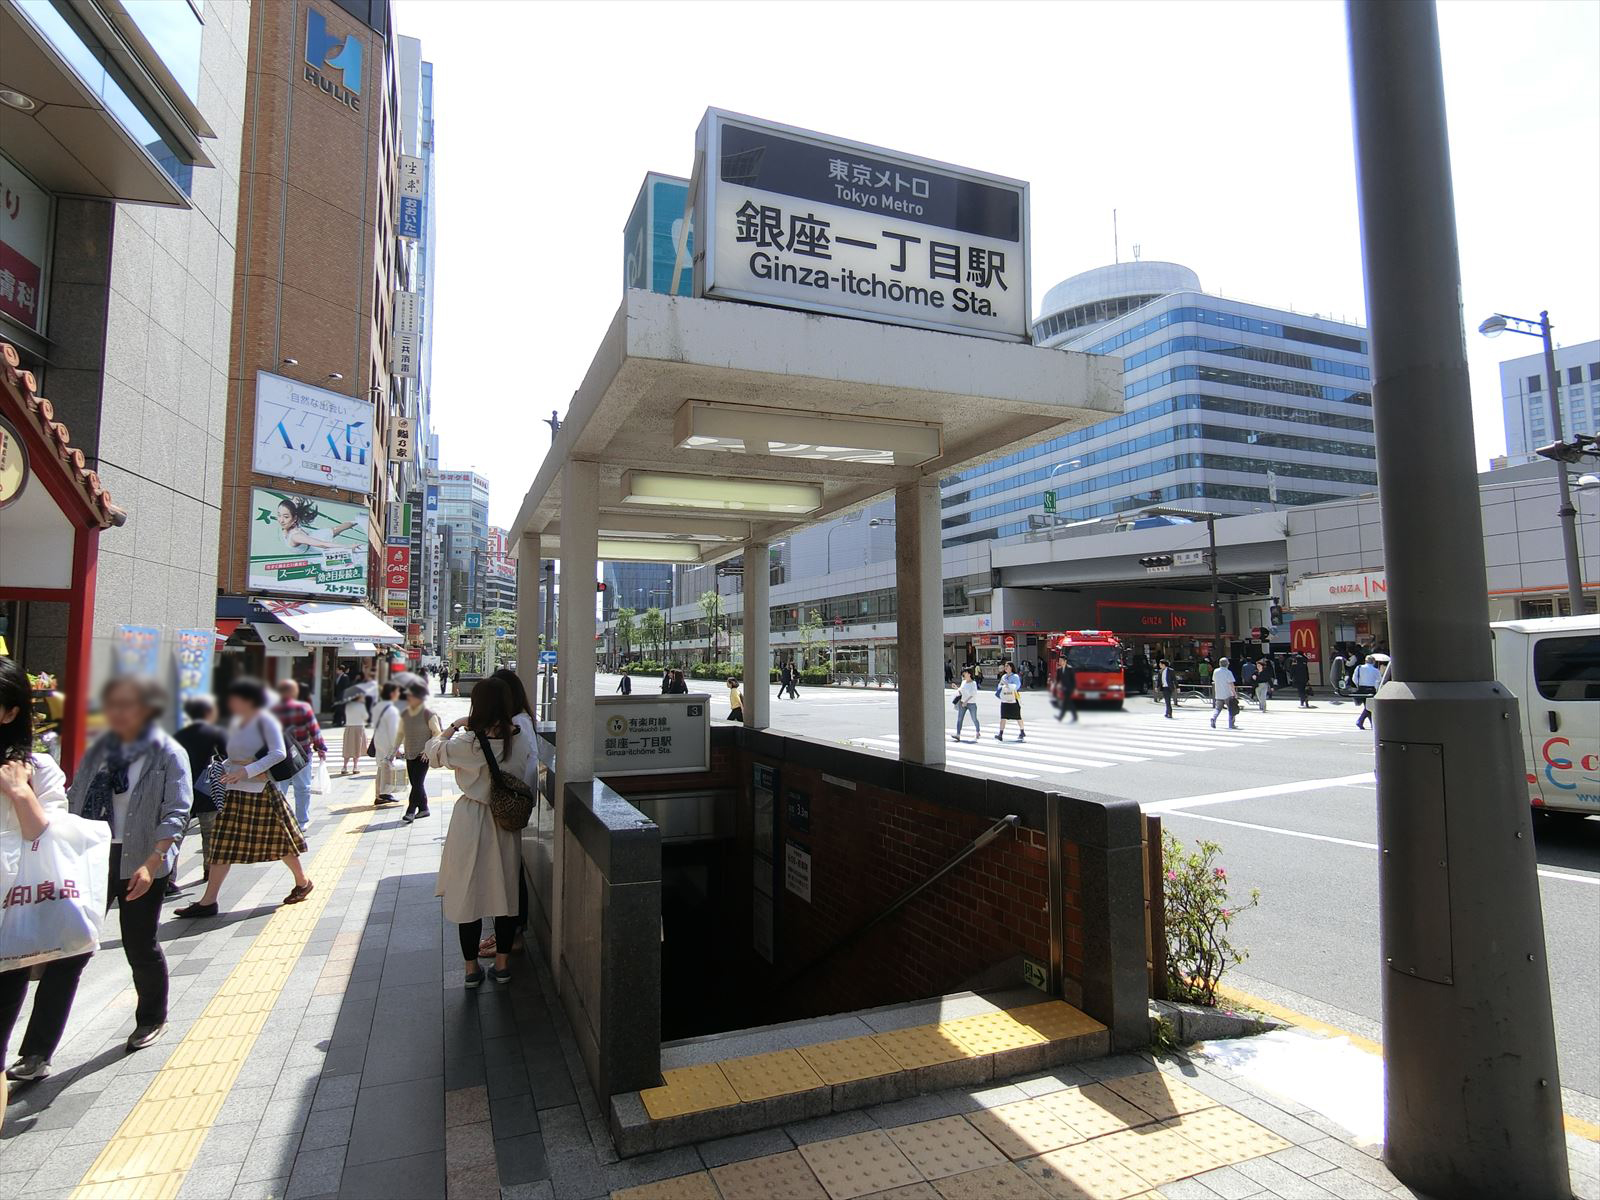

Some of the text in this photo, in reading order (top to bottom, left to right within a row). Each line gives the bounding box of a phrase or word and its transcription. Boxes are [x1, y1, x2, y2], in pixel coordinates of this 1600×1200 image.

[303, 67, 360, 112] HULIC
[828, 158, 929, 199] 東京メトロ
[835, 184, 923, 216] Tokyo Metro
[735, 200, 1009, 292] 銀座一丁目駅
[749, 251, 998, 318] Ginza-itchōme Sta.
[291, 392, 347, 415] 自然な出会い
[1329, 584, 1361, 596] GINZA
[1141, 616, 1162, 625] GINZA
[629, 717, 667, 727] 有楽町線
[604, 736, 672, 749] 銀座一丁目駅
[3, 880, 80, 909] 印良品
